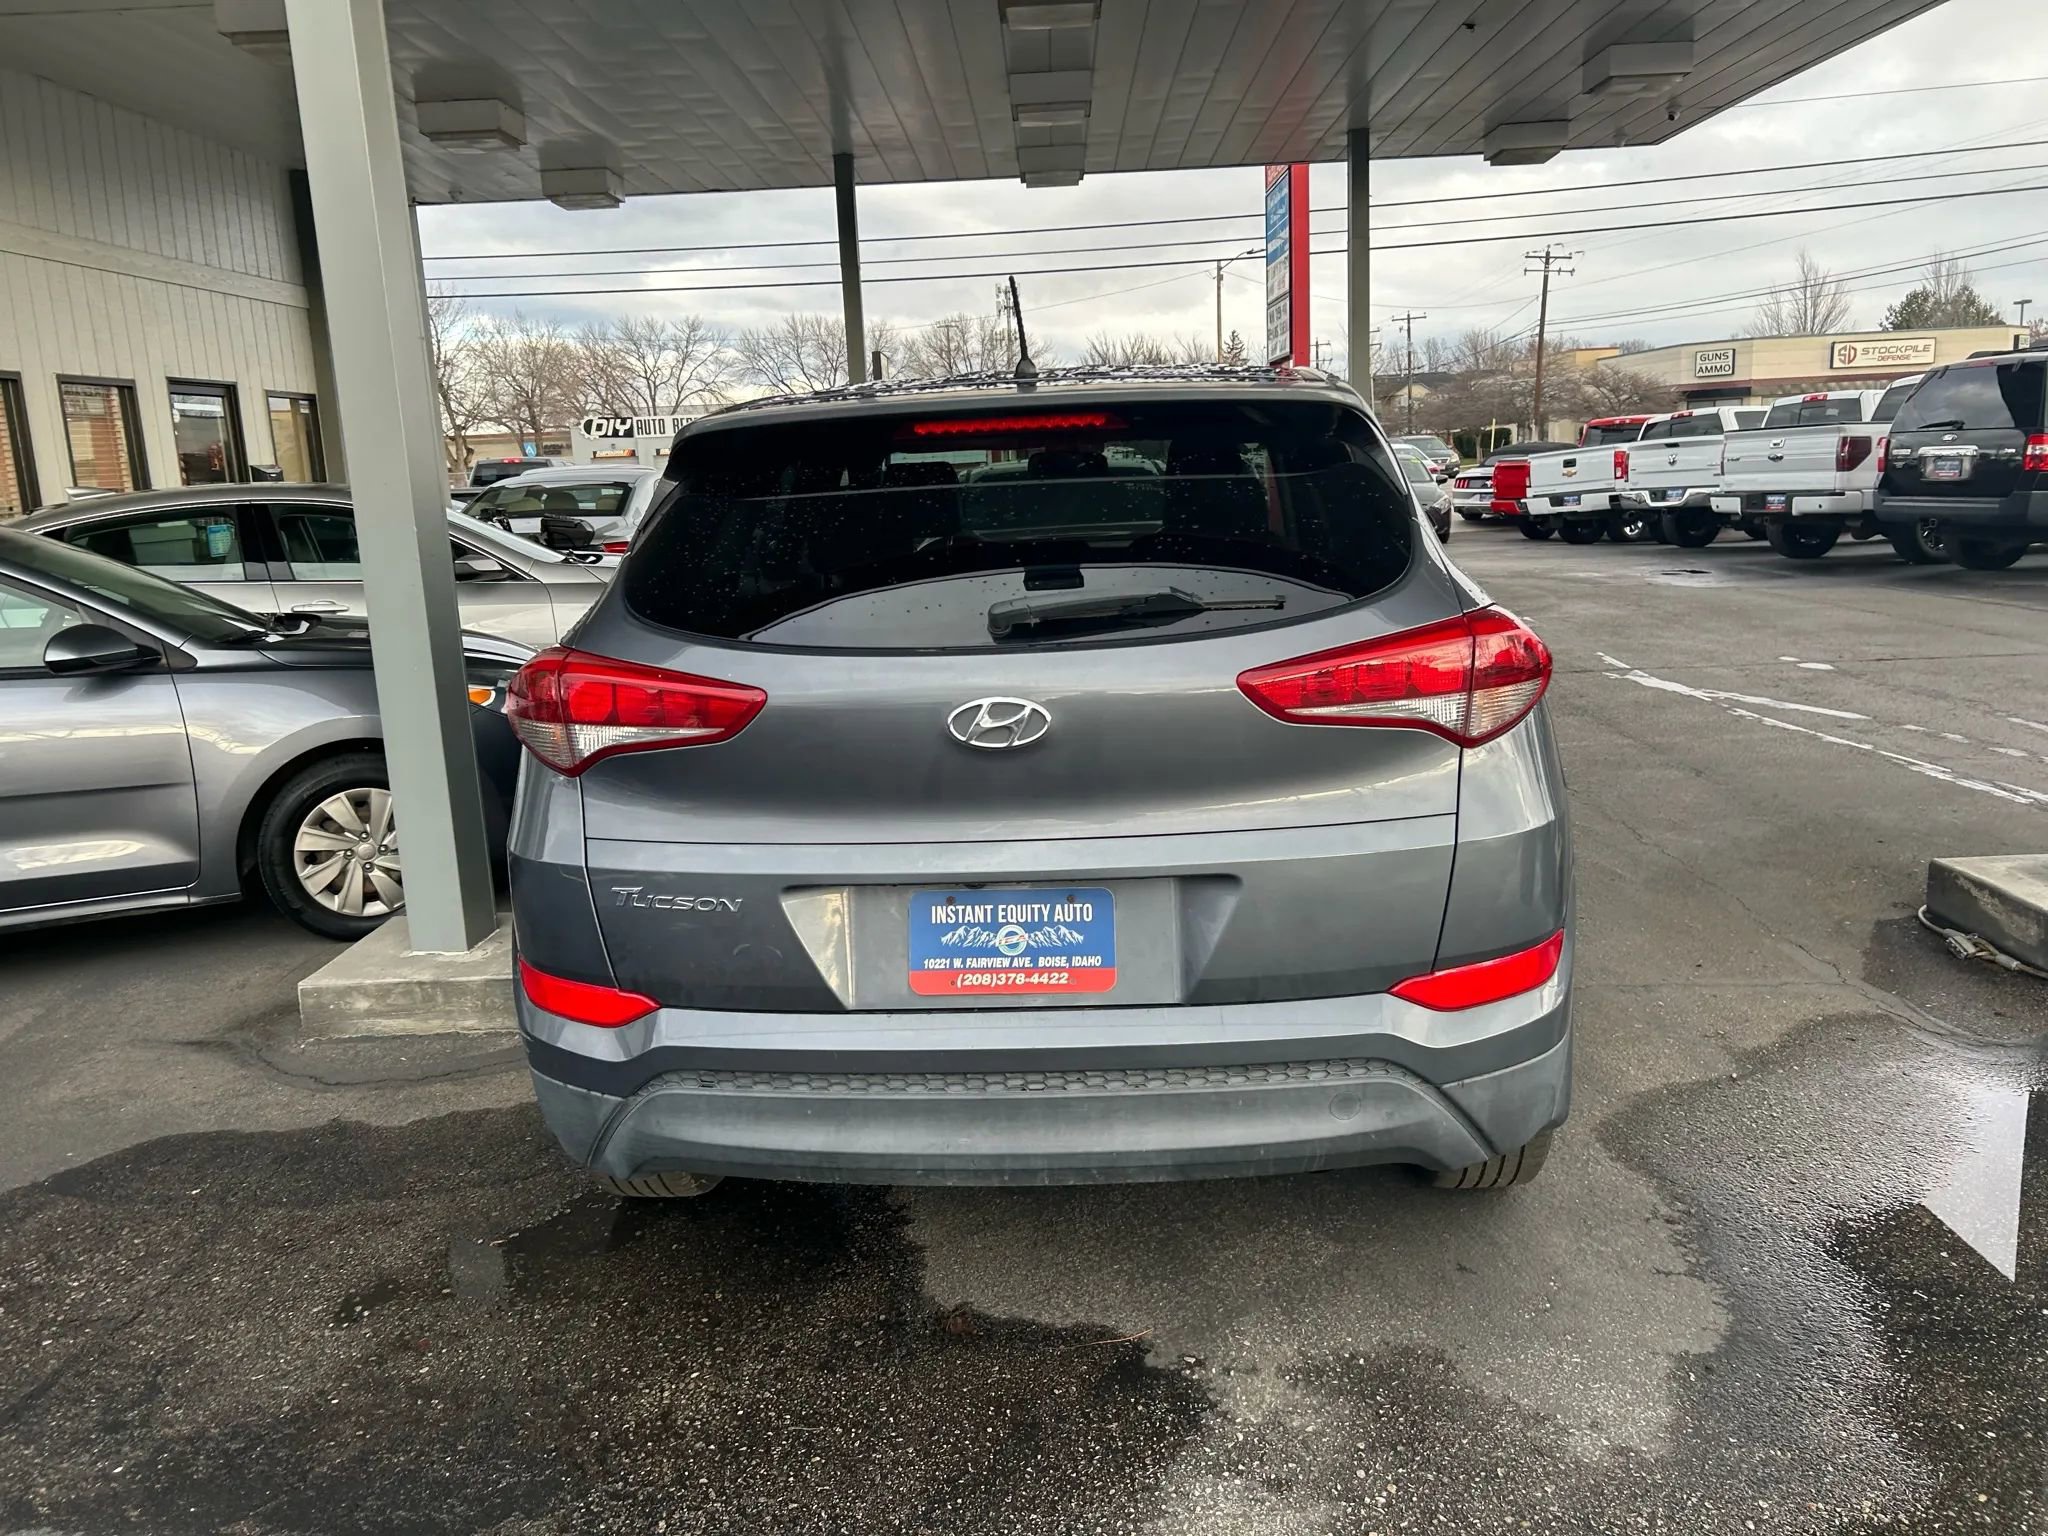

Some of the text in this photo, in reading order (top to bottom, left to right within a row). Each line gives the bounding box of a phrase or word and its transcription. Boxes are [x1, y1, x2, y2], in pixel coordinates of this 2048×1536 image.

[1861, 344, 1932, 355] STOCKPILE
[1700, 352, 1729, 361] GUNS
[1697, 364, 1731, 374] AMMO
[590, 418, 632, 436] DIY
[636, 418, 666, 435] AUTO
[931, 903, 1093, 924] INSTANT EQUITY AUTO
[923, 956, 1102, 969] 10221 W. FAIRVIEW AVE. BOISE, IDAHO
[956, 972, 1068, 988] (208)378-4422
